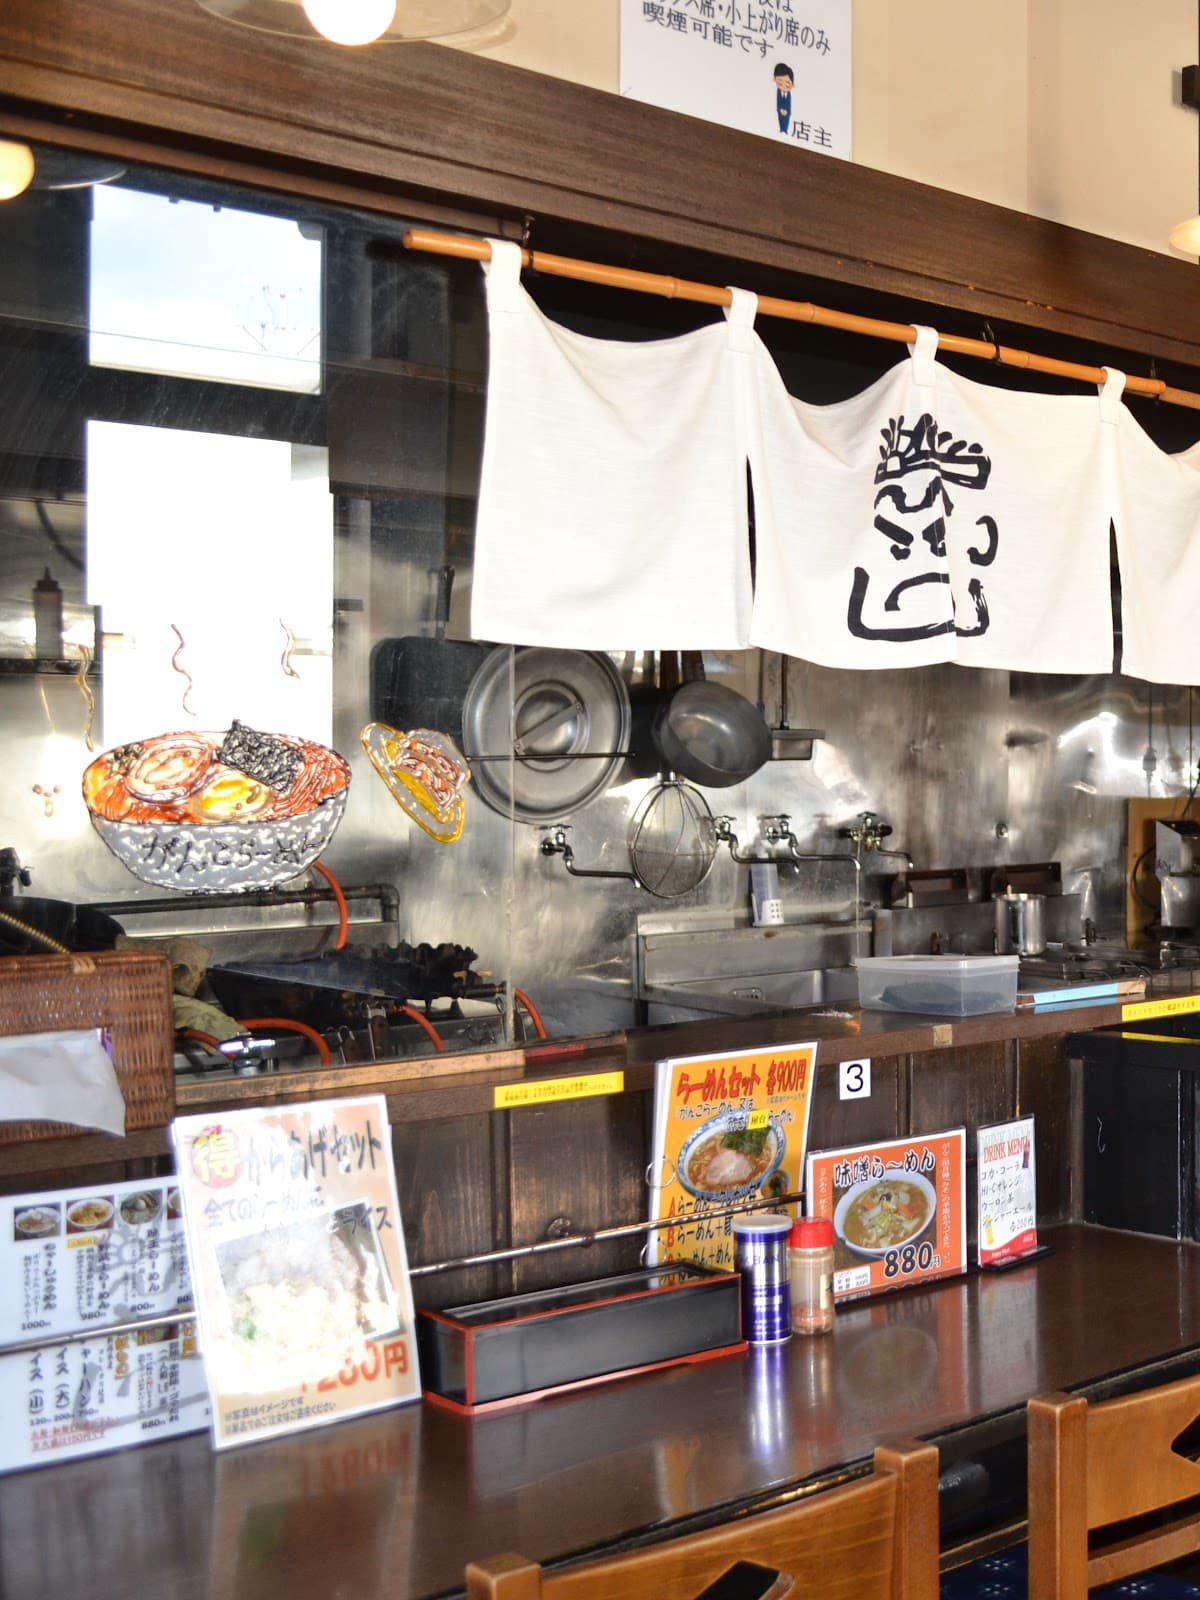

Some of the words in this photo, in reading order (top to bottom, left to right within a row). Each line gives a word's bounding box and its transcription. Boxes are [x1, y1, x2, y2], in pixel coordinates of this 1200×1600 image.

[642, 2, 775, 58] 喫煙可能です
[791, 120, 833, 148] 店主
[676, 1064, 761, 1104] らーめんセット
[767, 1058, 807, 1096] 各900円
[846, 1063, 864, 1094] 3
[192, 1129, 239, 1180] 得
[983, 1142, 1006, 1164] DRINK
[1007, 1136, 1030, 1154] MENU
[884, 1242, 941, 1278] 880円
